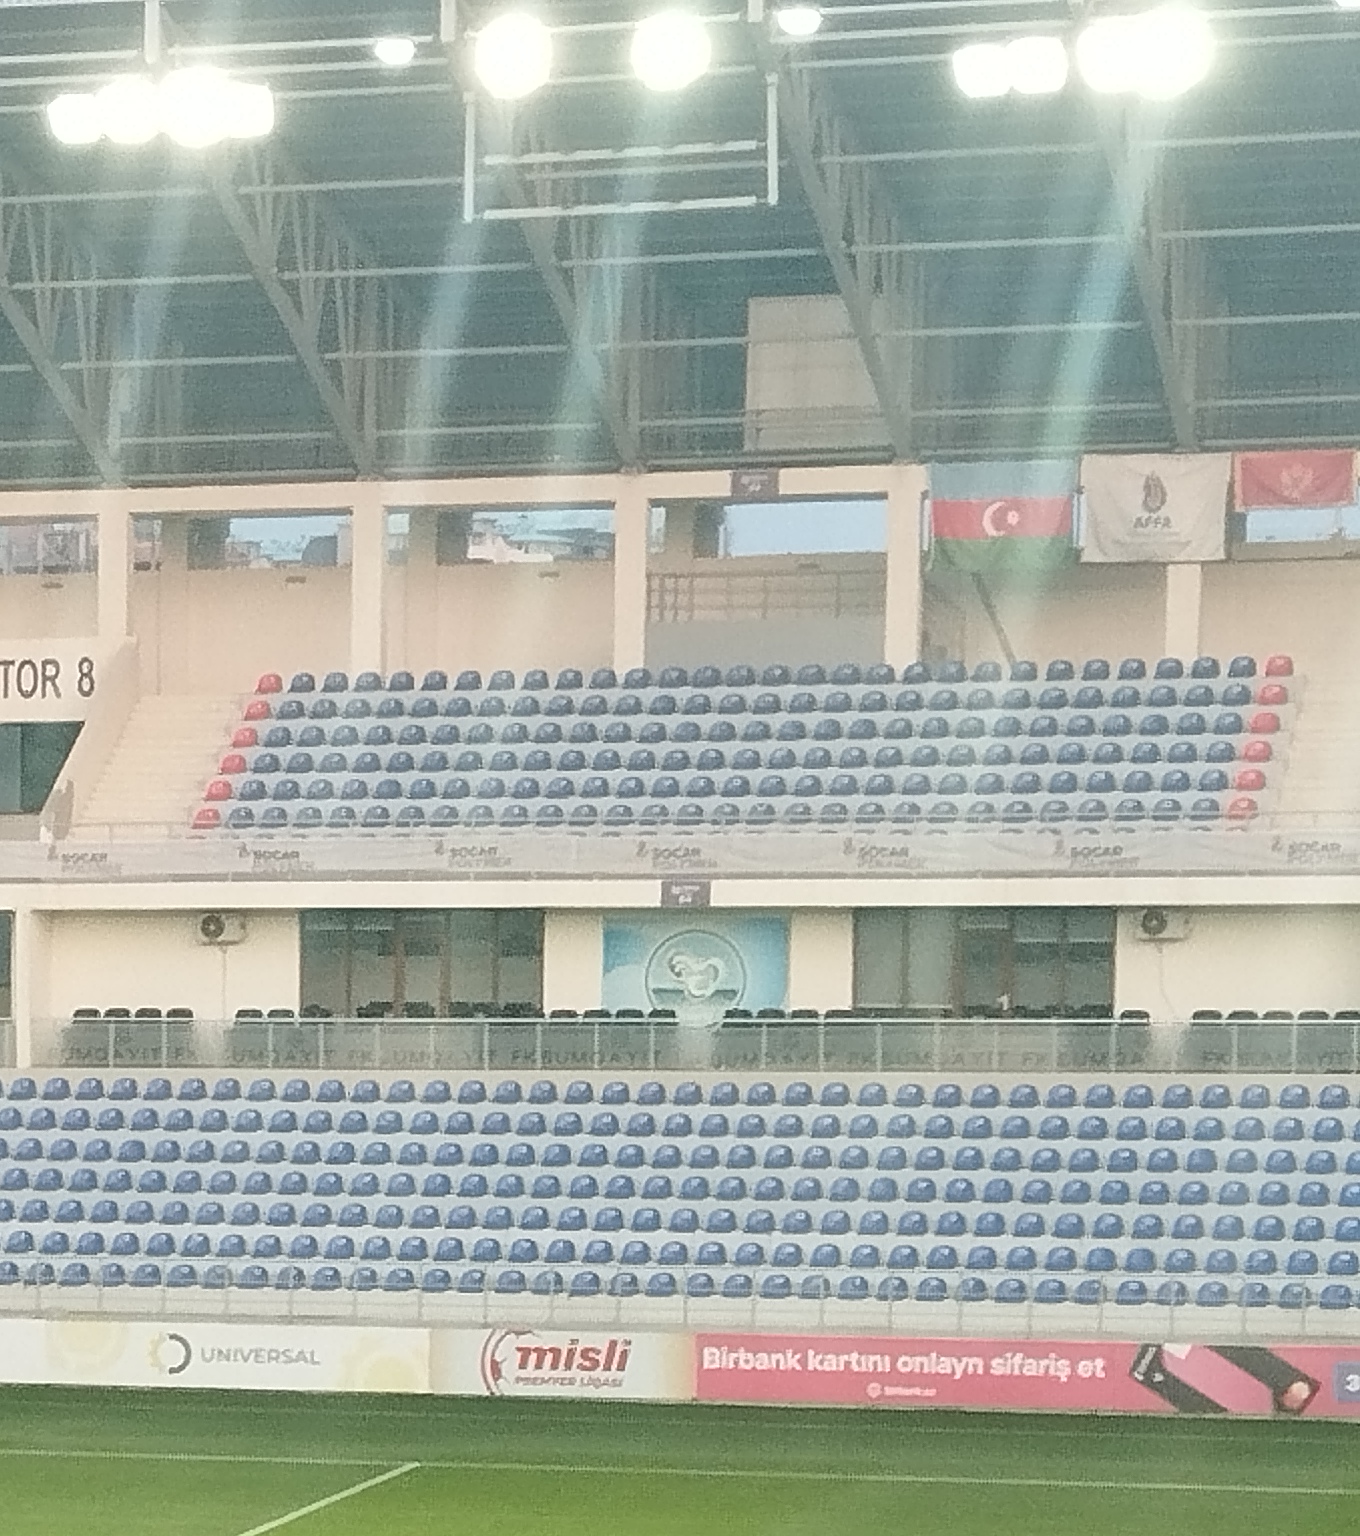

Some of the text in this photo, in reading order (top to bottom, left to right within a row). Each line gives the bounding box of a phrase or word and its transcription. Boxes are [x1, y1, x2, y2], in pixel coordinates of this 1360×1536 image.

[77, 656, 95, 698] 8
[201, 1347, 321, 1366] UNIVERSAL
[515, 1338, 632, 1372] misli
[702, 1346, 802, 1371] Birbank
[807, 1349, 891, 1372] kartını
[896, 1351, 984, 1380] onlayn
[989, 1352, 1072, 1382] sifariş
